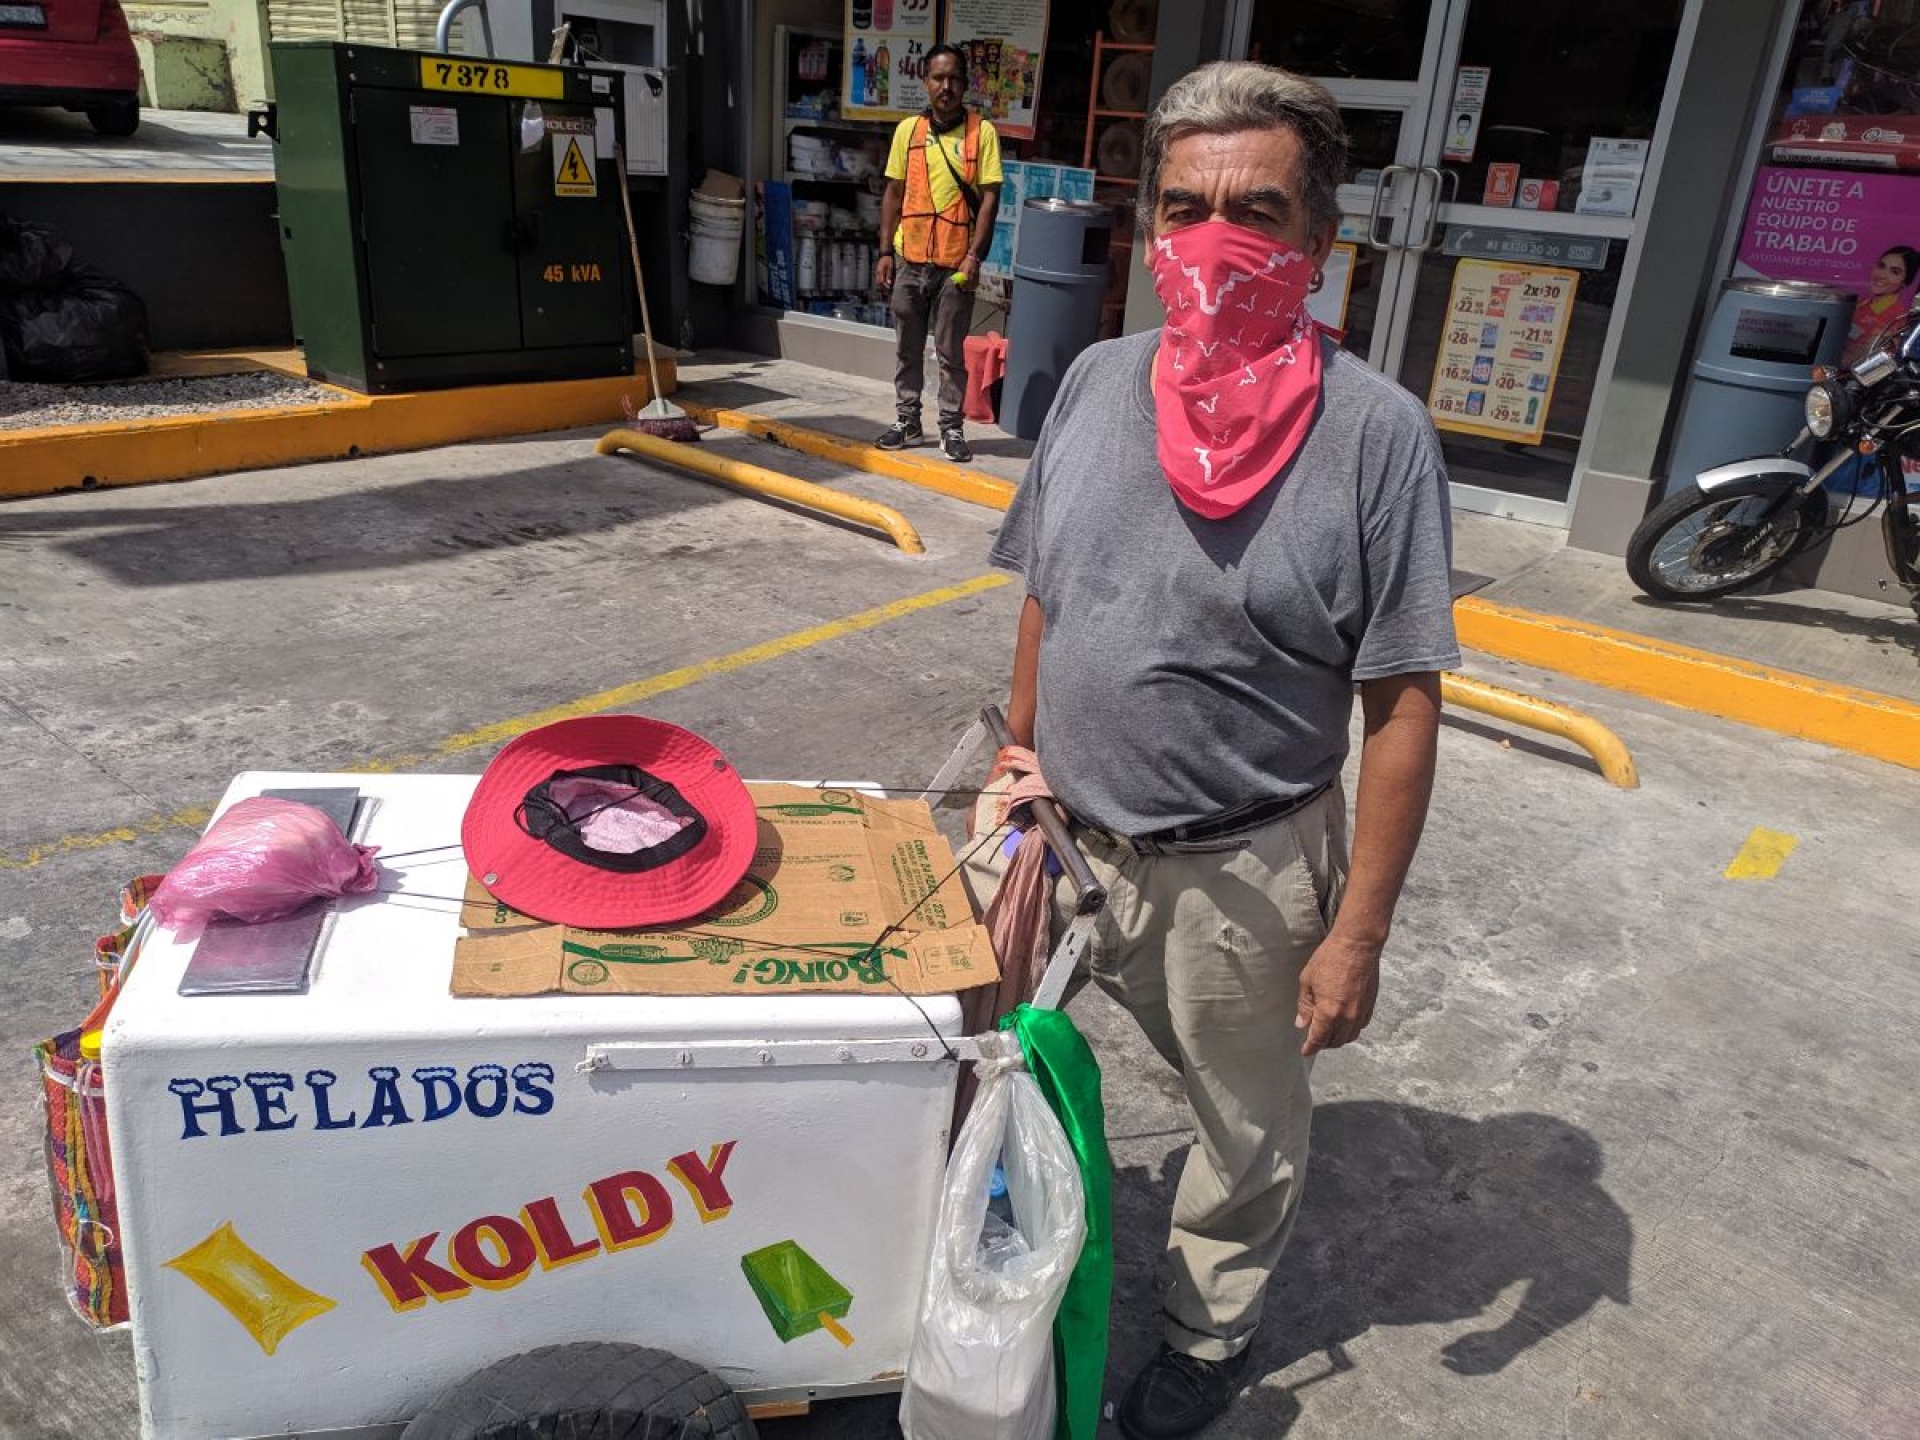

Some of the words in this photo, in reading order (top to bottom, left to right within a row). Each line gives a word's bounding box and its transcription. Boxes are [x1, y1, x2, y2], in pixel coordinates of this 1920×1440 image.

[436, 63, 509, 89] 7378
[1766, 171, 1845, 198] ÚNETE
[1845, 181, 1864, 199] A
[1760, 197, 1839, 213] NUESTRO
[1756, 212, 1828, 231] EQUIPO
[1831, 218, 1859, 233] DE
[1754, 230, 1858, 255] TRABAJO
[543, 263, 564, 283] 45
[571, 263, 602, 283] kVA
[733, 948, 892, 985] BOING!
[168, 1062, 555, 1139] HELADOS
[361, 1140, 738, 1312] KOLDY
